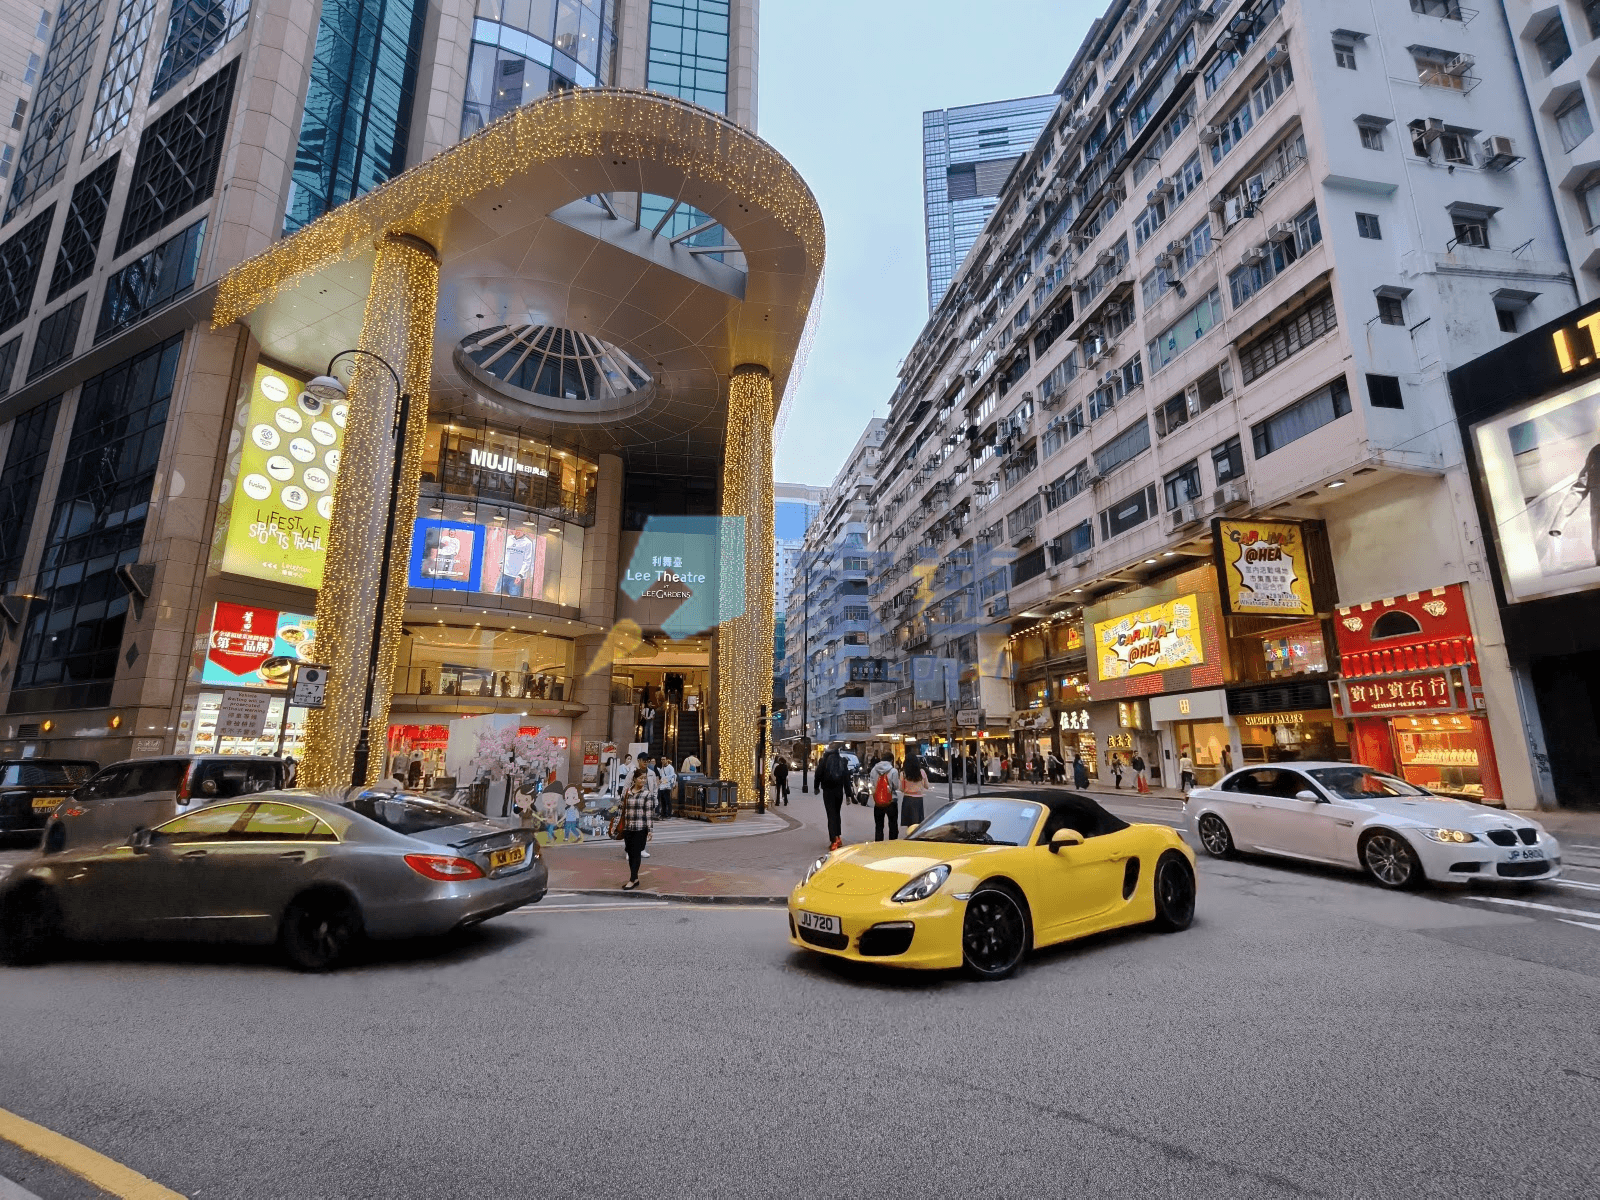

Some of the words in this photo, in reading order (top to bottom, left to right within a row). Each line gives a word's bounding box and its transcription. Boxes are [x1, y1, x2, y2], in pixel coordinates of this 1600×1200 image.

[470, 449, 514, 473] MUJI
[517, 463, 549, 477] 無印良品
[248, 522, 290, 550] SPORTS
[292, 531, 325, 552] TRAIL
[652, 556, 683, 568] 利舞臺
[1245, 547, 1282, 564] @HEA
[627, 569, 651, 581] Lee
[655, 570, 706, 583] Theatre
[1117, 621, 1174, 646] CARNIVAL
[216, 637, 270, 654] 第一品牌
[1128, 640, 1161, 663] @HEA
[802, 913, 811, 927] JU
[813, 915, 833, 931] 720
